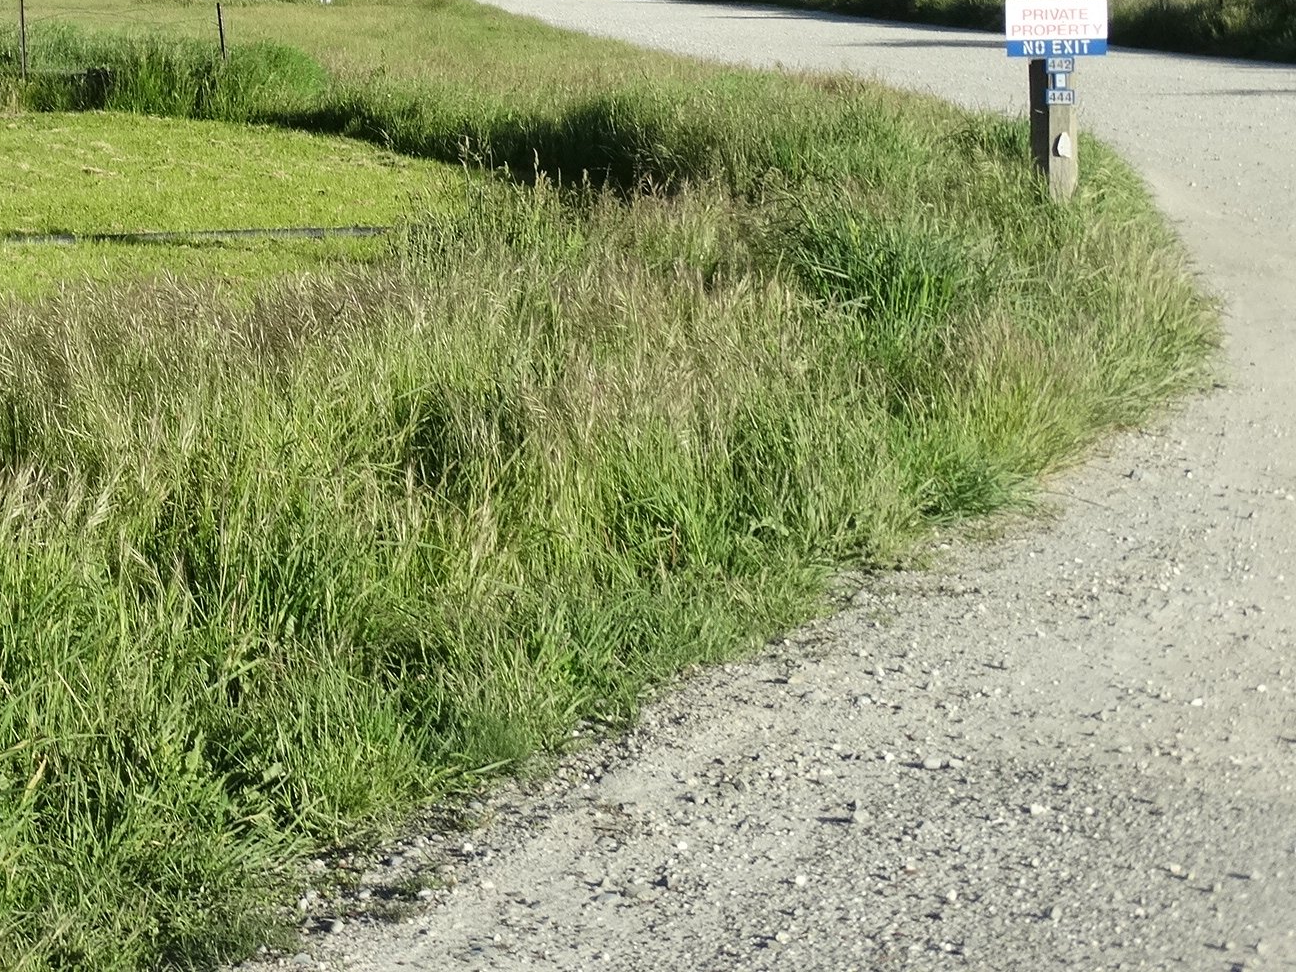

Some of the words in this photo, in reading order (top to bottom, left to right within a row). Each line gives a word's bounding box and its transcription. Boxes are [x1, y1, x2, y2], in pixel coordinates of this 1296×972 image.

[1022, 8, 1088, 21] PRIVATE
[1011, 23, 1103, 37] PROPERTY
[1023, 40, 1045, 55] NO
[1051, 39, 1090, 54] EXIT
[1048, 59, 1071, 69] 442
[1049, 92, 1071, 102] 444
